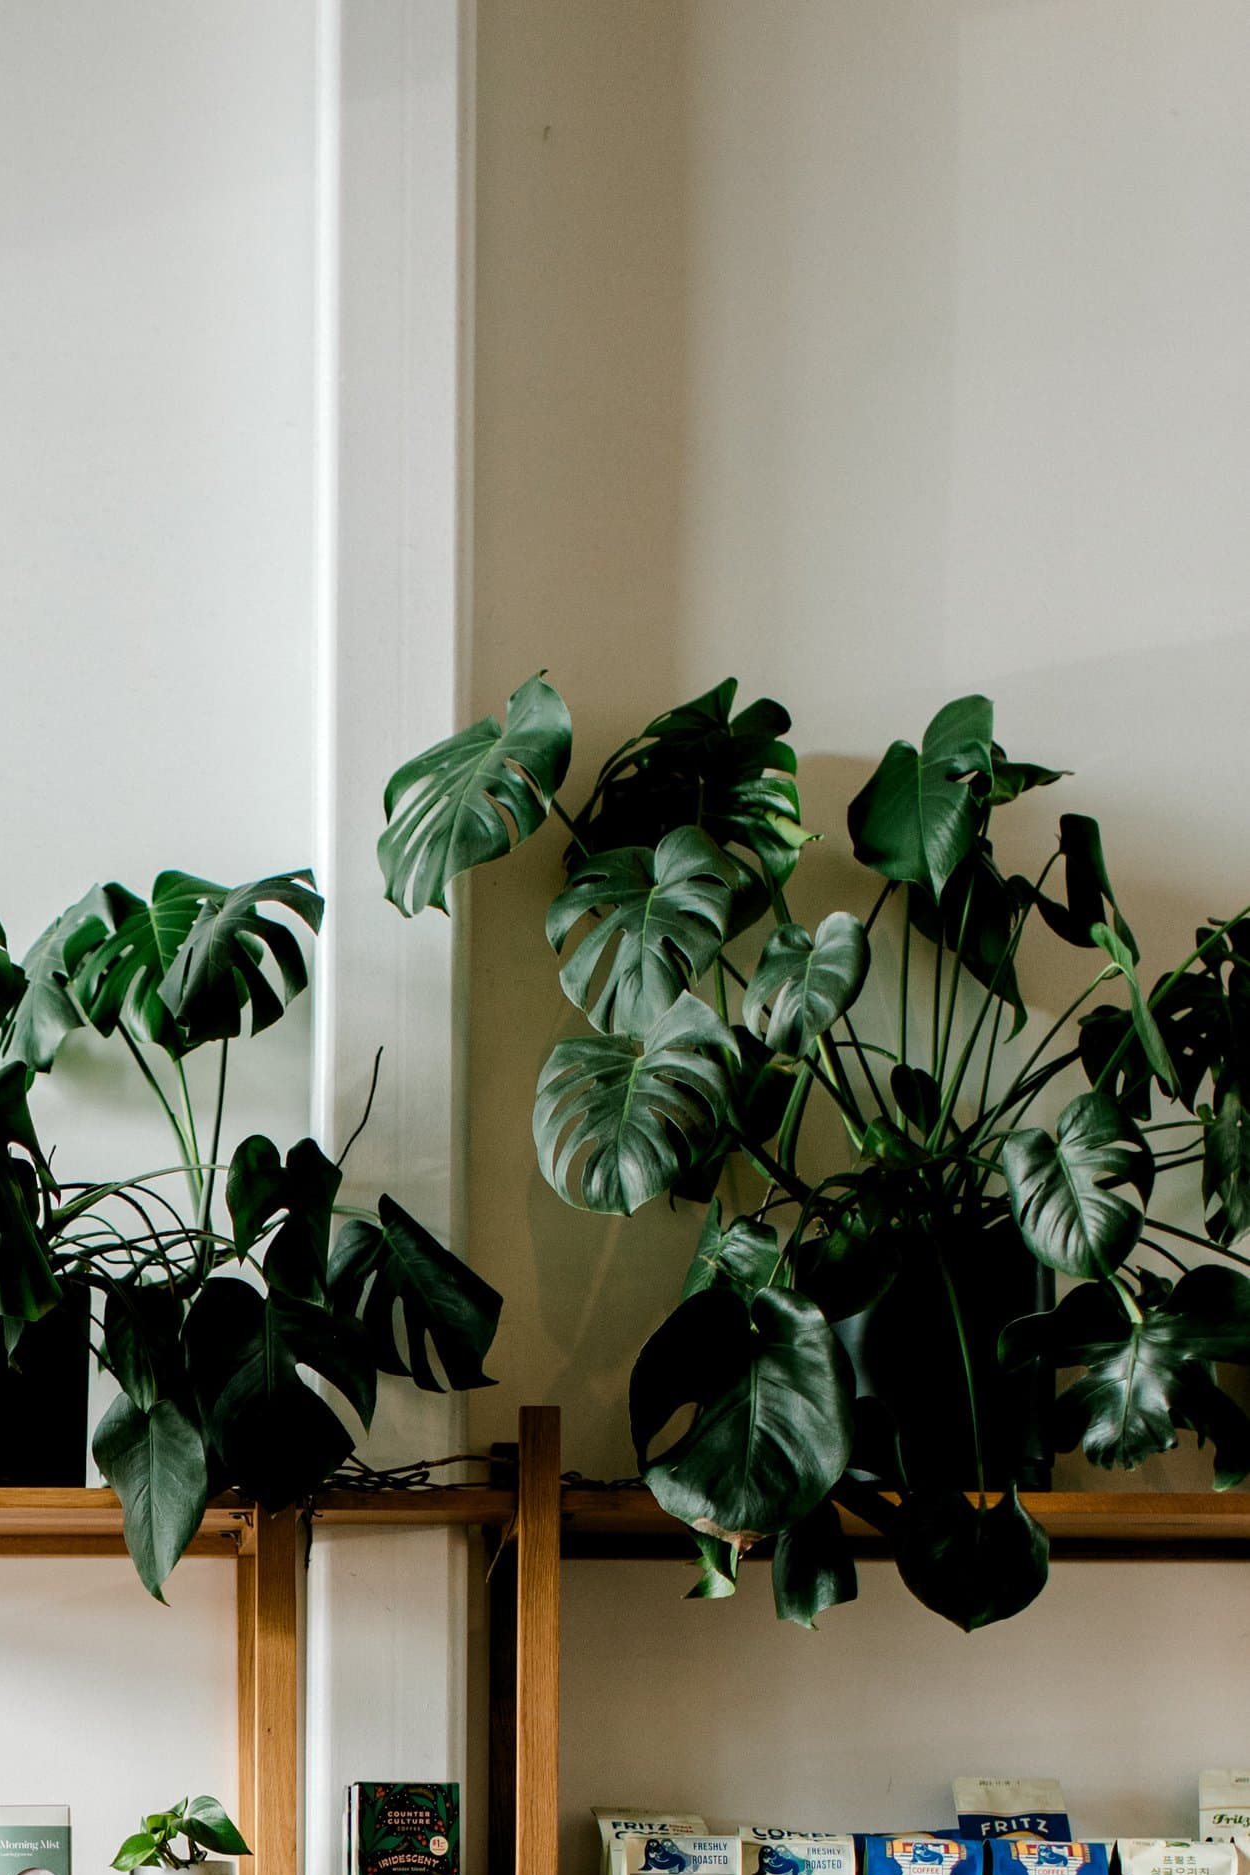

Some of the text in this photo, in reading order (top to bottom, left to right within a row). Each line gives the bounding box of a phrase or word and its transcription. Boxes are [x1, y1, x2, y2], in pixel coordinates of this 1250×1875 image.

[387, 1810, 430, 1818] COUNTER
[611, 1821, 670, 1832] FRITZ
[980, 1818, 1050, 1836] FRITZ
[0, 1840, 60, 1851] Morning Mist
[693, 1842, 728, 1851] FRESHLY
[807, 1848, 841, 1856] FRESHLY
[378, 1854, 440, 1869] IRIDESCENT
[692, 1856, 728, 1865] ROASTED
[805, 1860, 842, 1869] ROASTED
[912, 1865, 940, 1874] COFFEE
[1038, 1868, 1066, 1875] COFFEE
